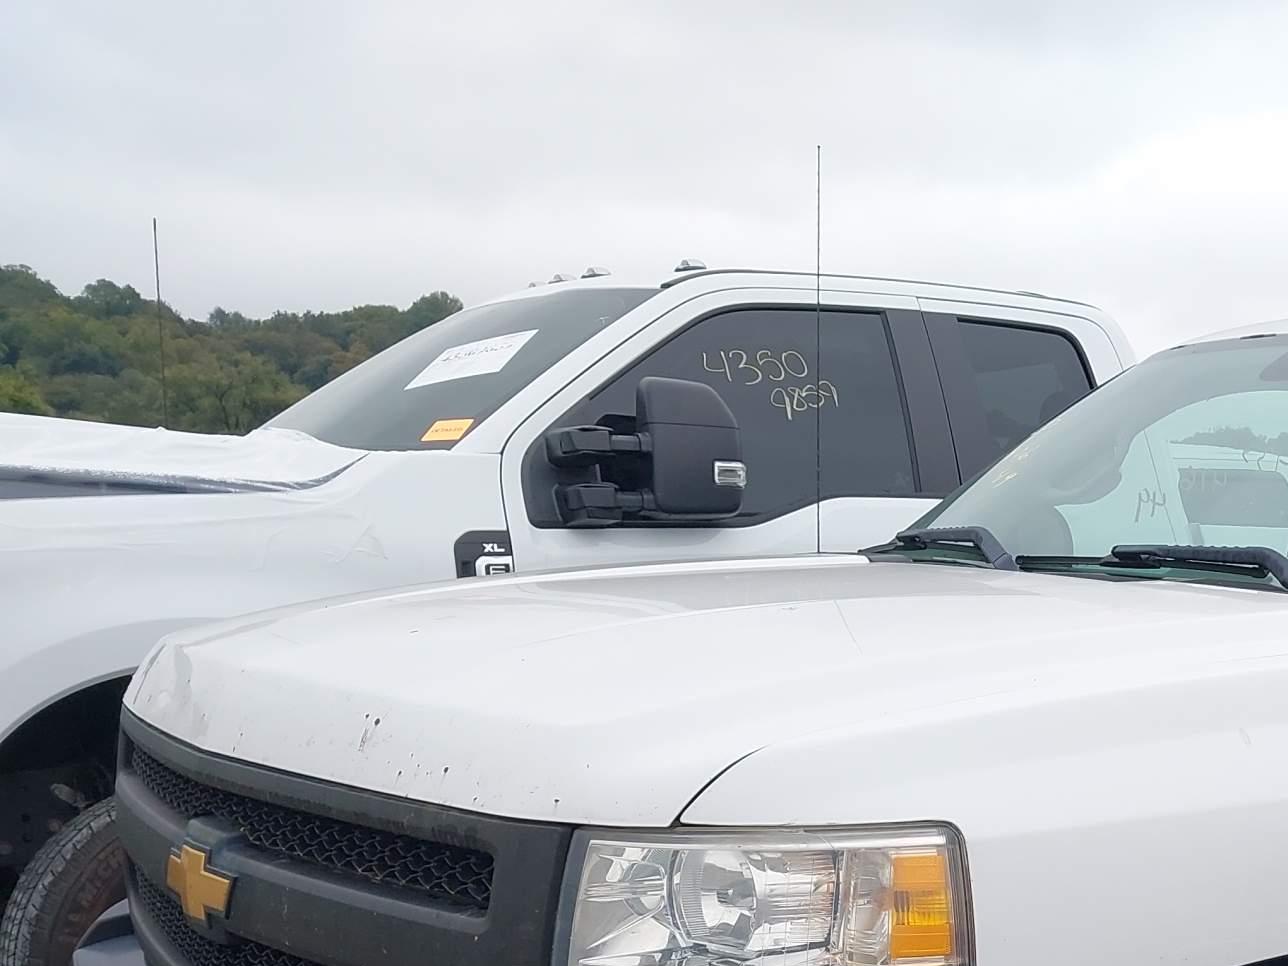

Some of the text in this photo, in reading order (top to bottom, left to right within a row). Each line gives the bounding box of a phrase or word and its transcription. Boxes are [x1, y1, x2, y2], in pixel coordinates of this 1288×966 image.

[702, 349, 809, 386] 4350
[770, 380, 839, 421] 9859
[482, 543, 506, 553] XL
